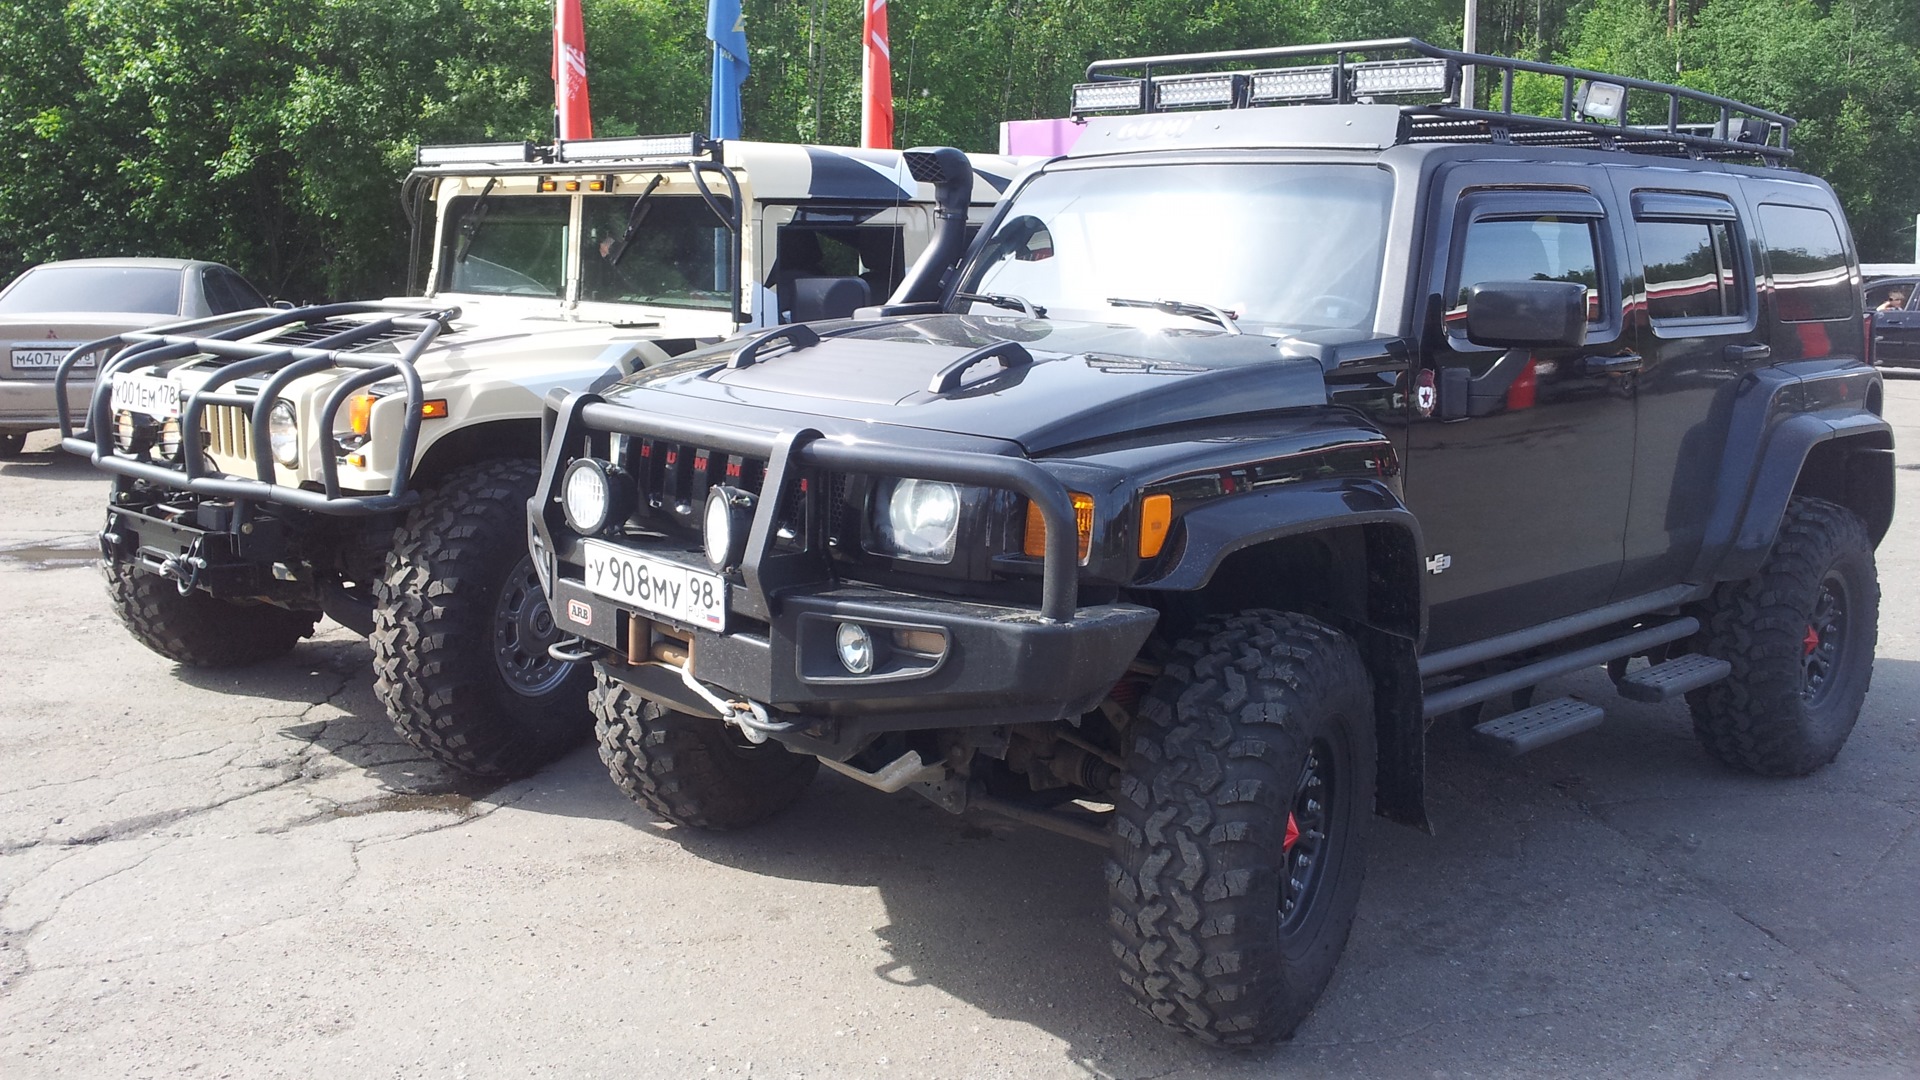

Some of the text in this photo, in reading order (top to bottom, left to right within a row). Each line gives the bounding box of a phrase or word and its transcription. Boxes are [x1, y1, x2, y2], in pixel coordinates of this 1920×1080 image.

[16, 352, 67, 365] М407Н
[158, 384, 176, 405] 178
[689, 577, 714, 609] 98
[571, 604, 589, 621] ARB
[688, 605, 706, 620] RUS
